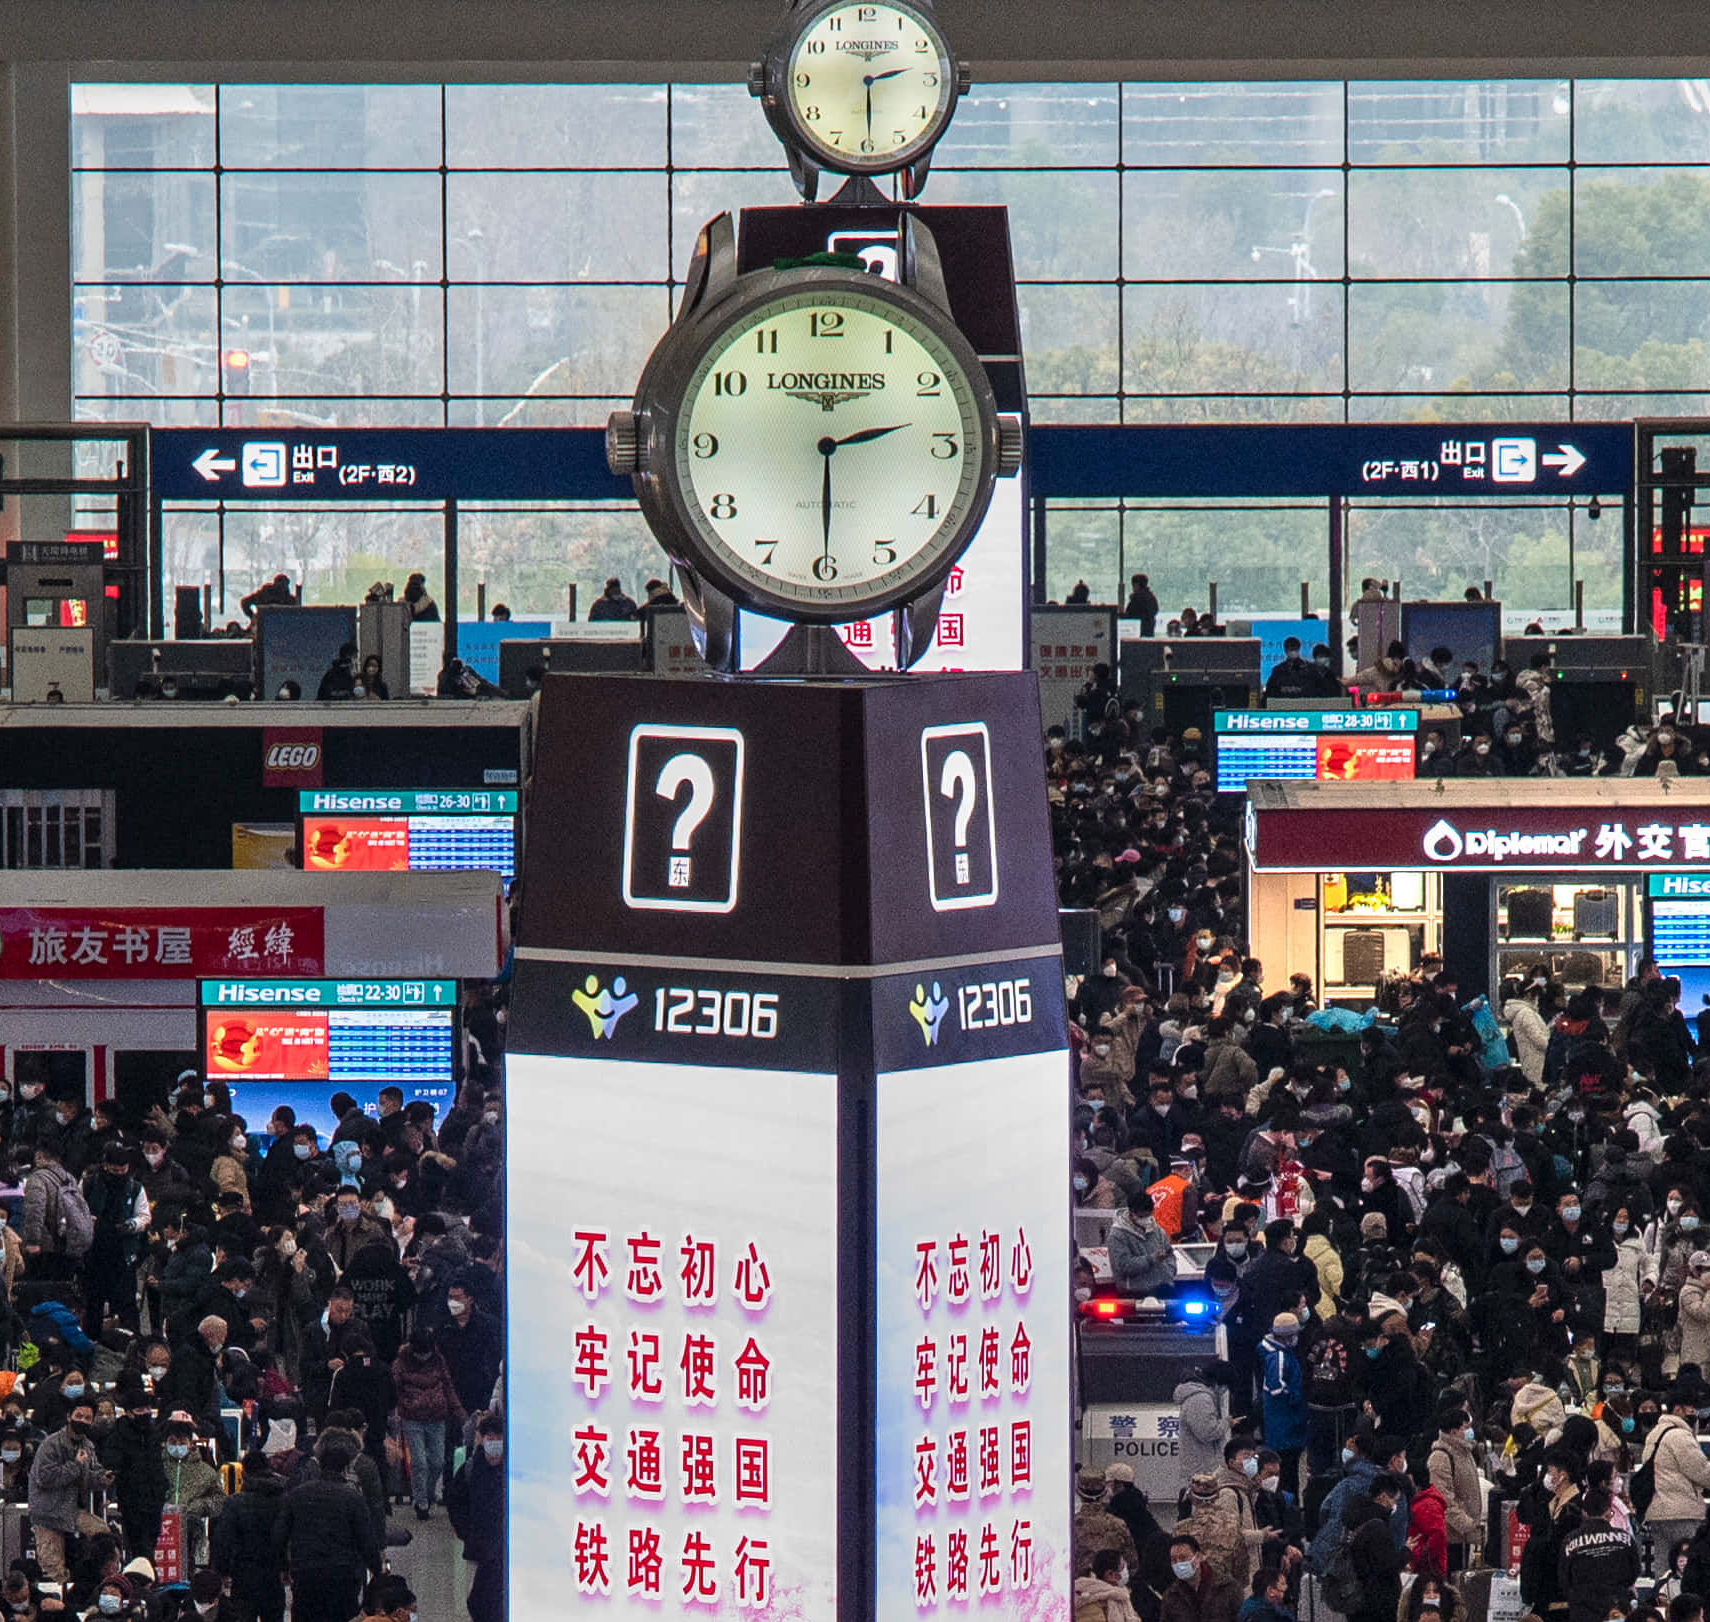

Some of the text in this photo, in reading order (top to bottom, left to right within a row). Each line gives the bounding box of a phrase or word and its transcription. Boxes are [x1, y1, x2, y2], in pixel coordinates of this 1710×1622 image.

[835, 40, 898, 50] LONGINES
[810, 313, 844, 337] 12
[756, 330, 779, 353] 11
[884, 330, 892, 353] 1
[714, 372, 747, 396] 10
[767, 373, 885, 391] LONGINES
[917, 372, 940, 396] 2
[292, 445, 338, 468] 出口
[693, 433, 719, 459] 9
[931, 433, 958, 459] 3
[1441, 441, 1487, 464] 出口
[293, 471, 314, 483] Exit
[1463, 467, 1485, 479] Exit
[710, 494, 737, 519] 8
[911, 494, 940, 519] 4
[755, 540, 779, 565] 7
[872, 540, 897, 564] 5
[811, 554, 838, 580] 6
[1227, 714, 1309, 729] Hisense
[267, 743, 320, 770] LEGO
[313, 794, 401, 809] Hisense
[1465, 828, 1587, 860] Diplomat
[29, 926, 295, 966] 旅友书屋 經緯
[218, 984, 401, 1002] Hisense 22-30
[958, 978, 1032, 1030] 12306
[655, 987, 780, 1038] 12306
[574, 1230, 771, 1303] 不忘初心
[916, 1226, 1032, 1304] 不忘初心
[575, 1325, 771, 1404] 牢记使命
[915, 1321, 1032, 1403] 牢记使命
[1109, 1415, 1180, 1438] 警察
[915, 1420, 1031, 1502] 交通强国
[1114, 1441, 1180, 1457] POLICE
[574, 1424, 770, 1503] 交通强国
[574, 1521, 771, 1603] 铁路先行
[915, 1518, 1032, 1599] 铁路先行
